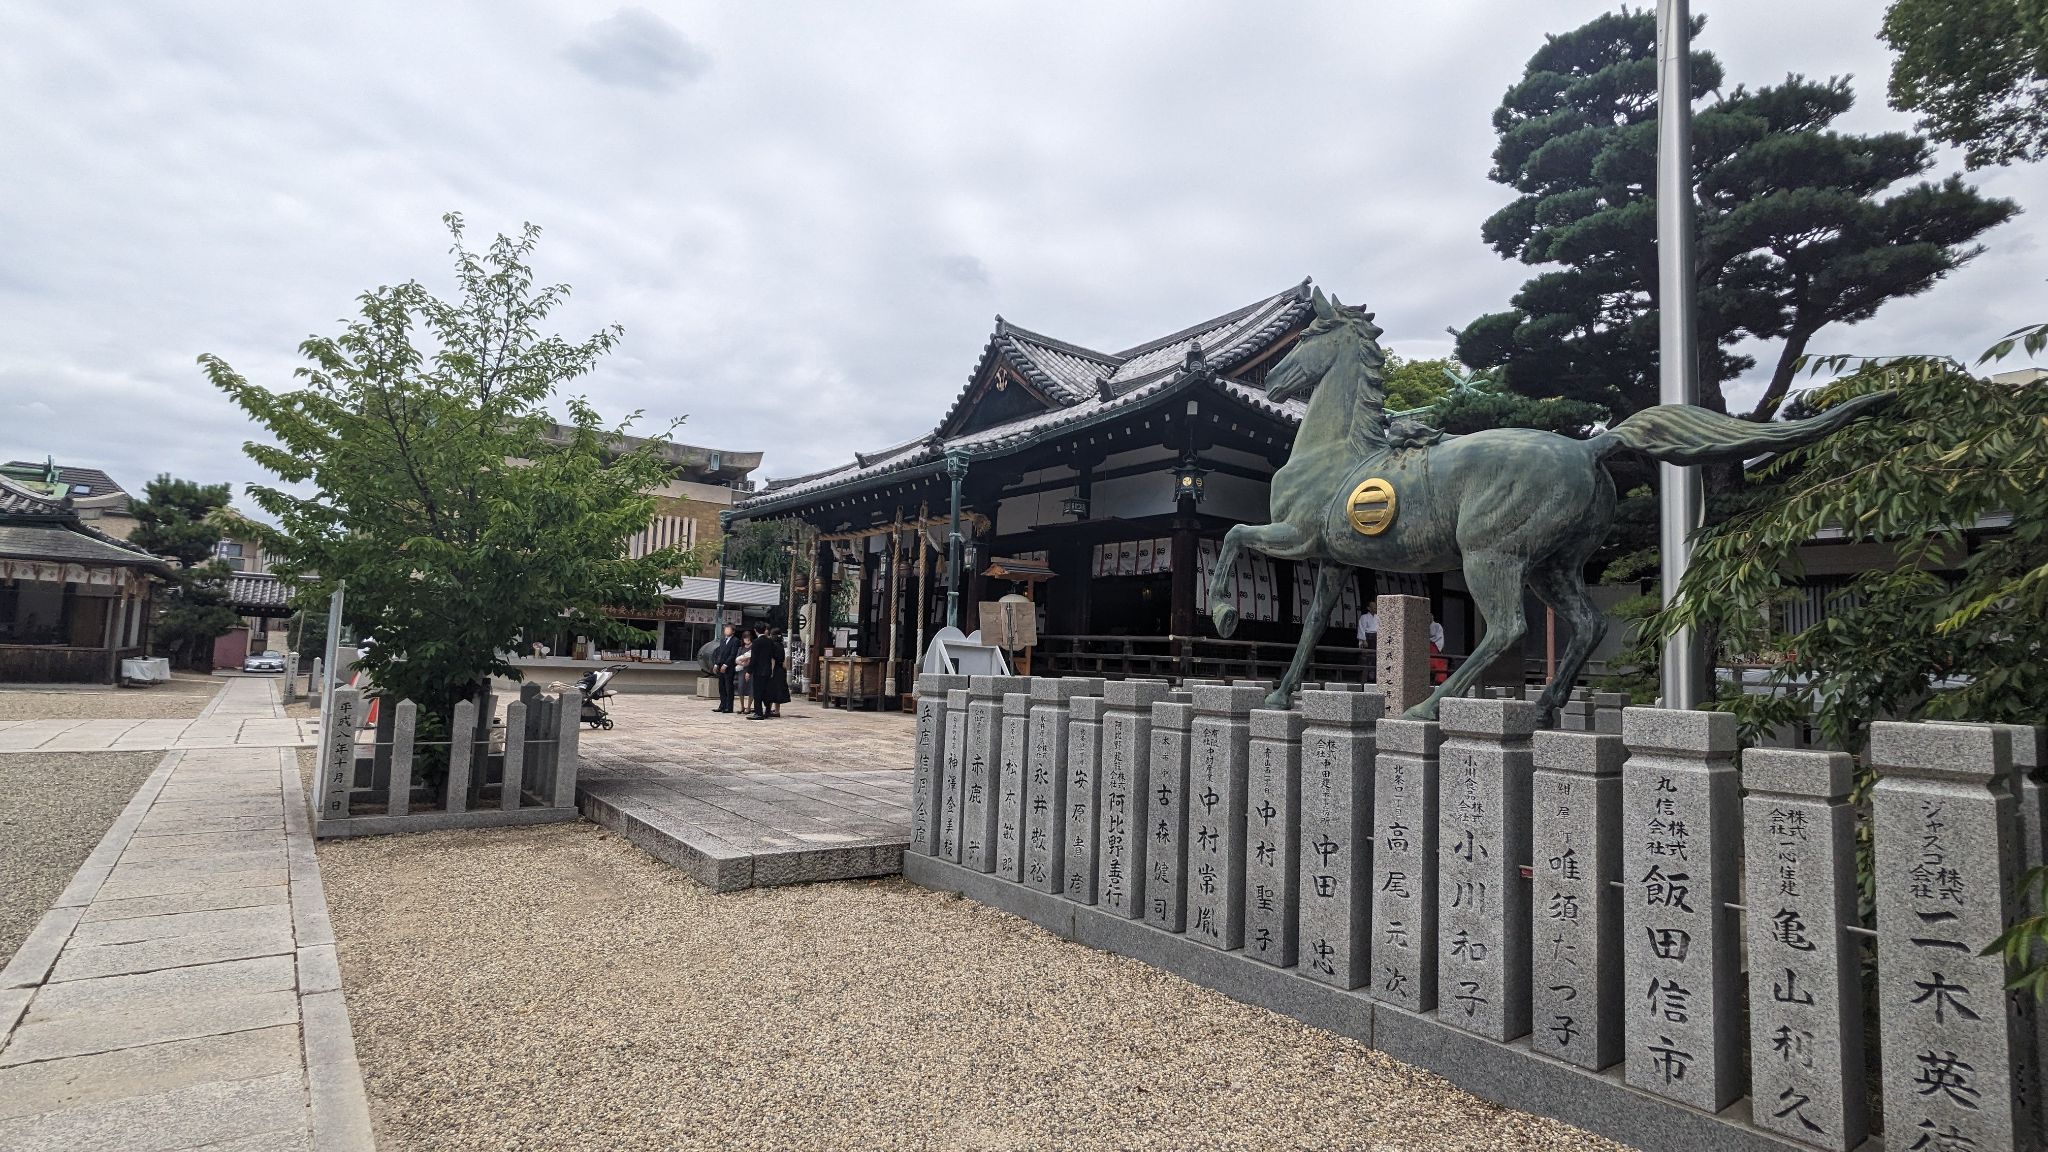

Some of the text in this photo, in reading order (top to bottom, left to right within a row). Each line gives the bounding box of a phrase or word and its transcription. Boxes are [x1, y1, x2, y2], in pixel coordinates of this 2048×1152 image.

[331, 702, 353, 811] 平成八年十月一日
[914, 704, 933, 845] 兵庫信用金庫
[1394, 764, 1405, 817] 北条口一丁目
[1457, 755, 1485, 823] 小川食品株式会社
[1646, 776, 1690, 862] 丸信株式会社
[1070, 769, 1089, 895] 安原貴彦
[1105, 792, 1126, 909] 阿比野善行
[1154, 784, 1172, 922] 古森健司
[1195, 786, 1220, 938] 中村常胤
[1255, 799, 1277, 952] 中村聖子
[1768, 808, 1809, 898] 株式会社一心住建
[1908, 799, 1966, 906] ジャスコ株式会社
[1311, 833, 1340, 975] 中田忠
[1381, 820, 1410, 999] 高尾元次
[1450, 829, 1489, 1019] 小川和子
[1548, 847, 1581, 1046] 唯須たつ子
[1640, 863, 1695, 1087] 飯田信市
[1771, 906, 1827, 1135] 亀山利久
